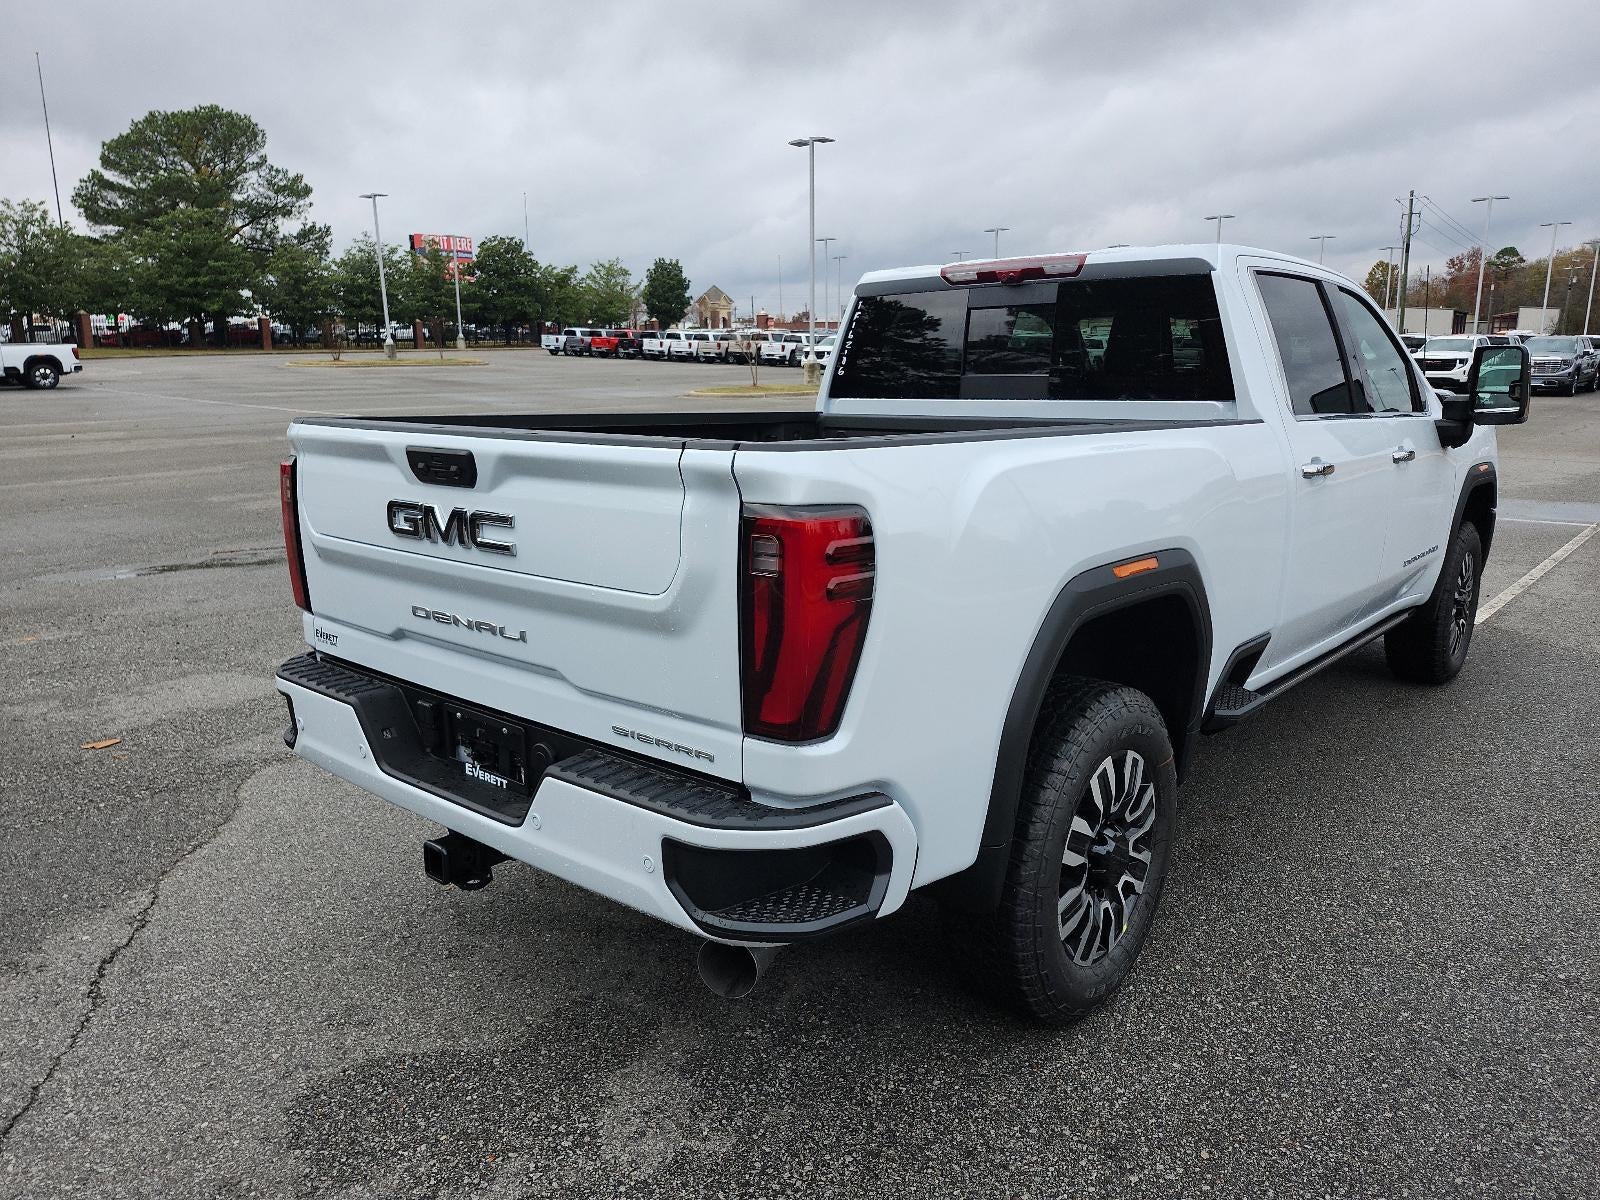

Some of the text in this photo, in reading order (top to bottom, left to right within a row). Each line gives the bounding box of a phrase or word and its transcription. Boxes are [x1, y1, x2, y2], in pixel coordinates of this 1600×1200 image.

[387, 499, 517, 557] GMC
[412, 605, 527, 644] DENALI
[611, 725, 715, 763] SIERRA
